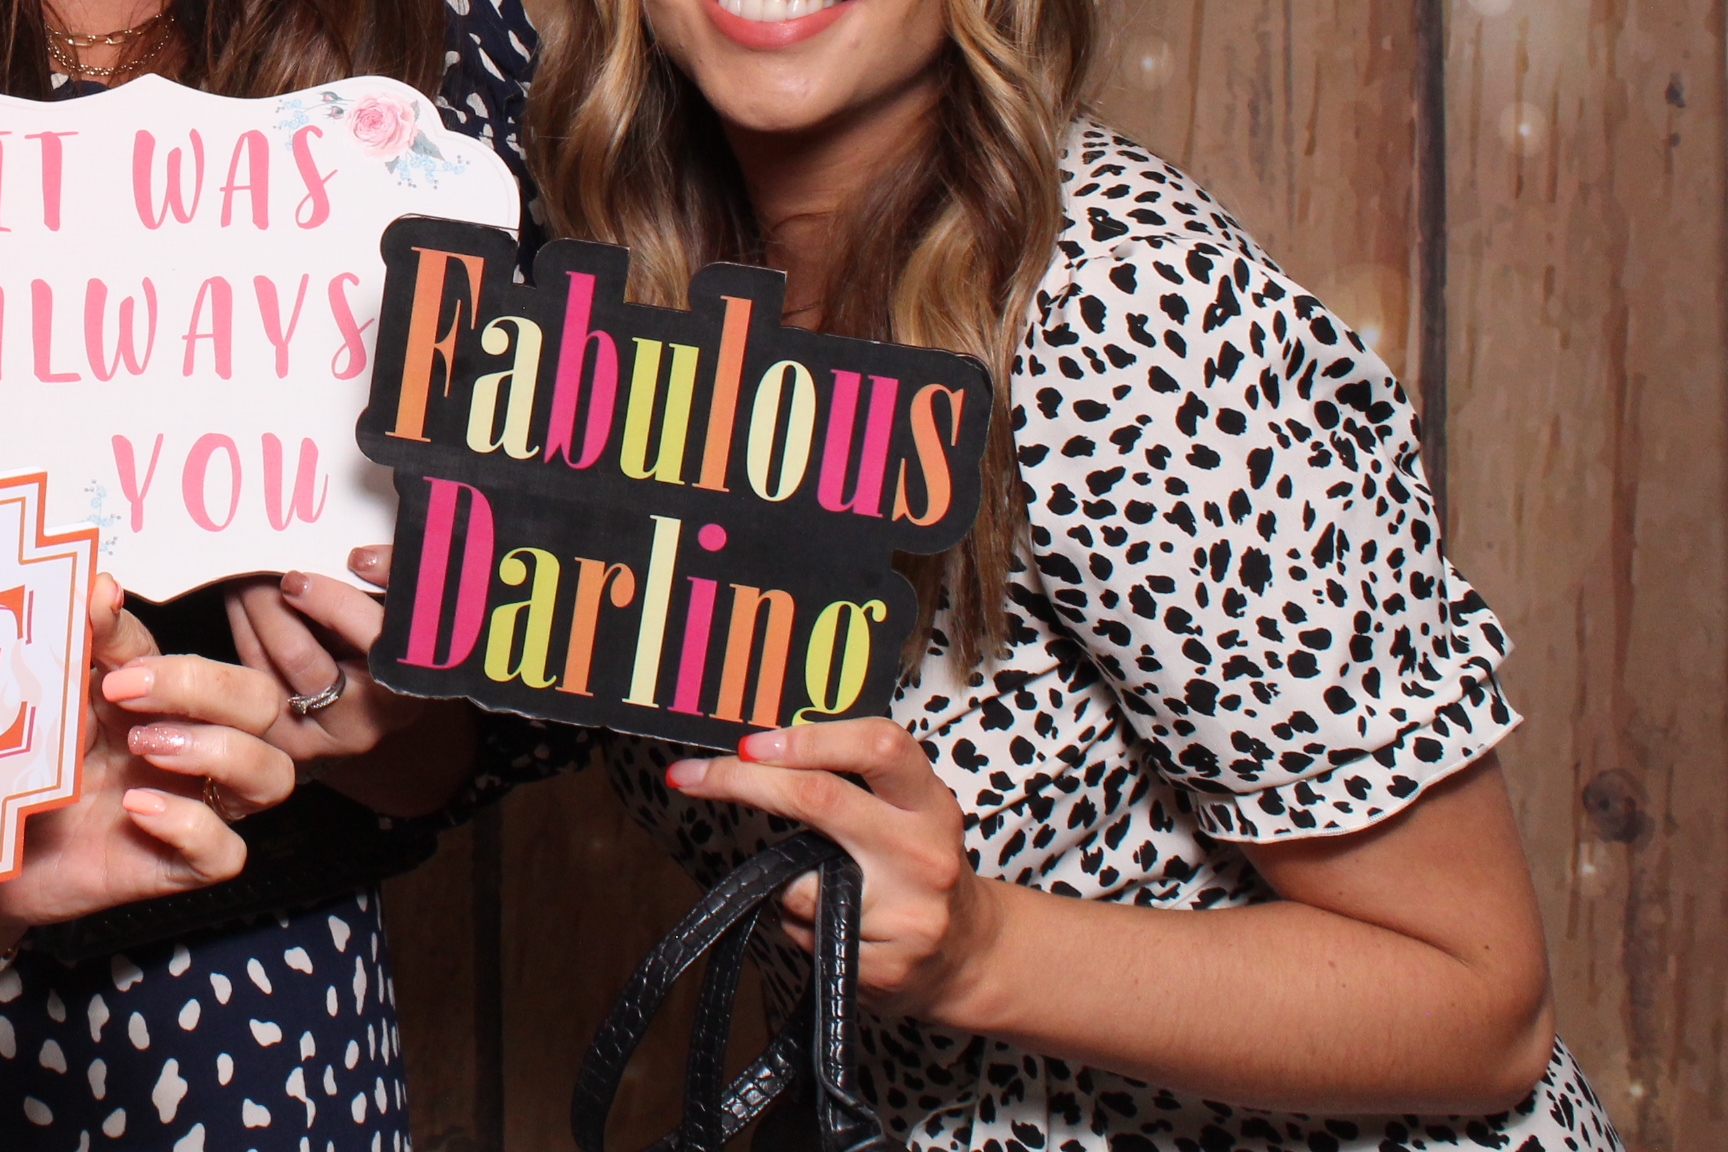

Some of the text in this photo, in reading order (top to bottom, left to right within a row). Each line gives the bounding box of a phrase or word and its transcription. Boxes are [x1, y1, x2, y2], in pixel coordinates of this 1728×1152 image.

[132, 124, 338, 231] WAS
[384, 246, 965, 527] Fabulous
[111, 432, 329, 534] YOU
[395, 475, 887, 730] Darling
